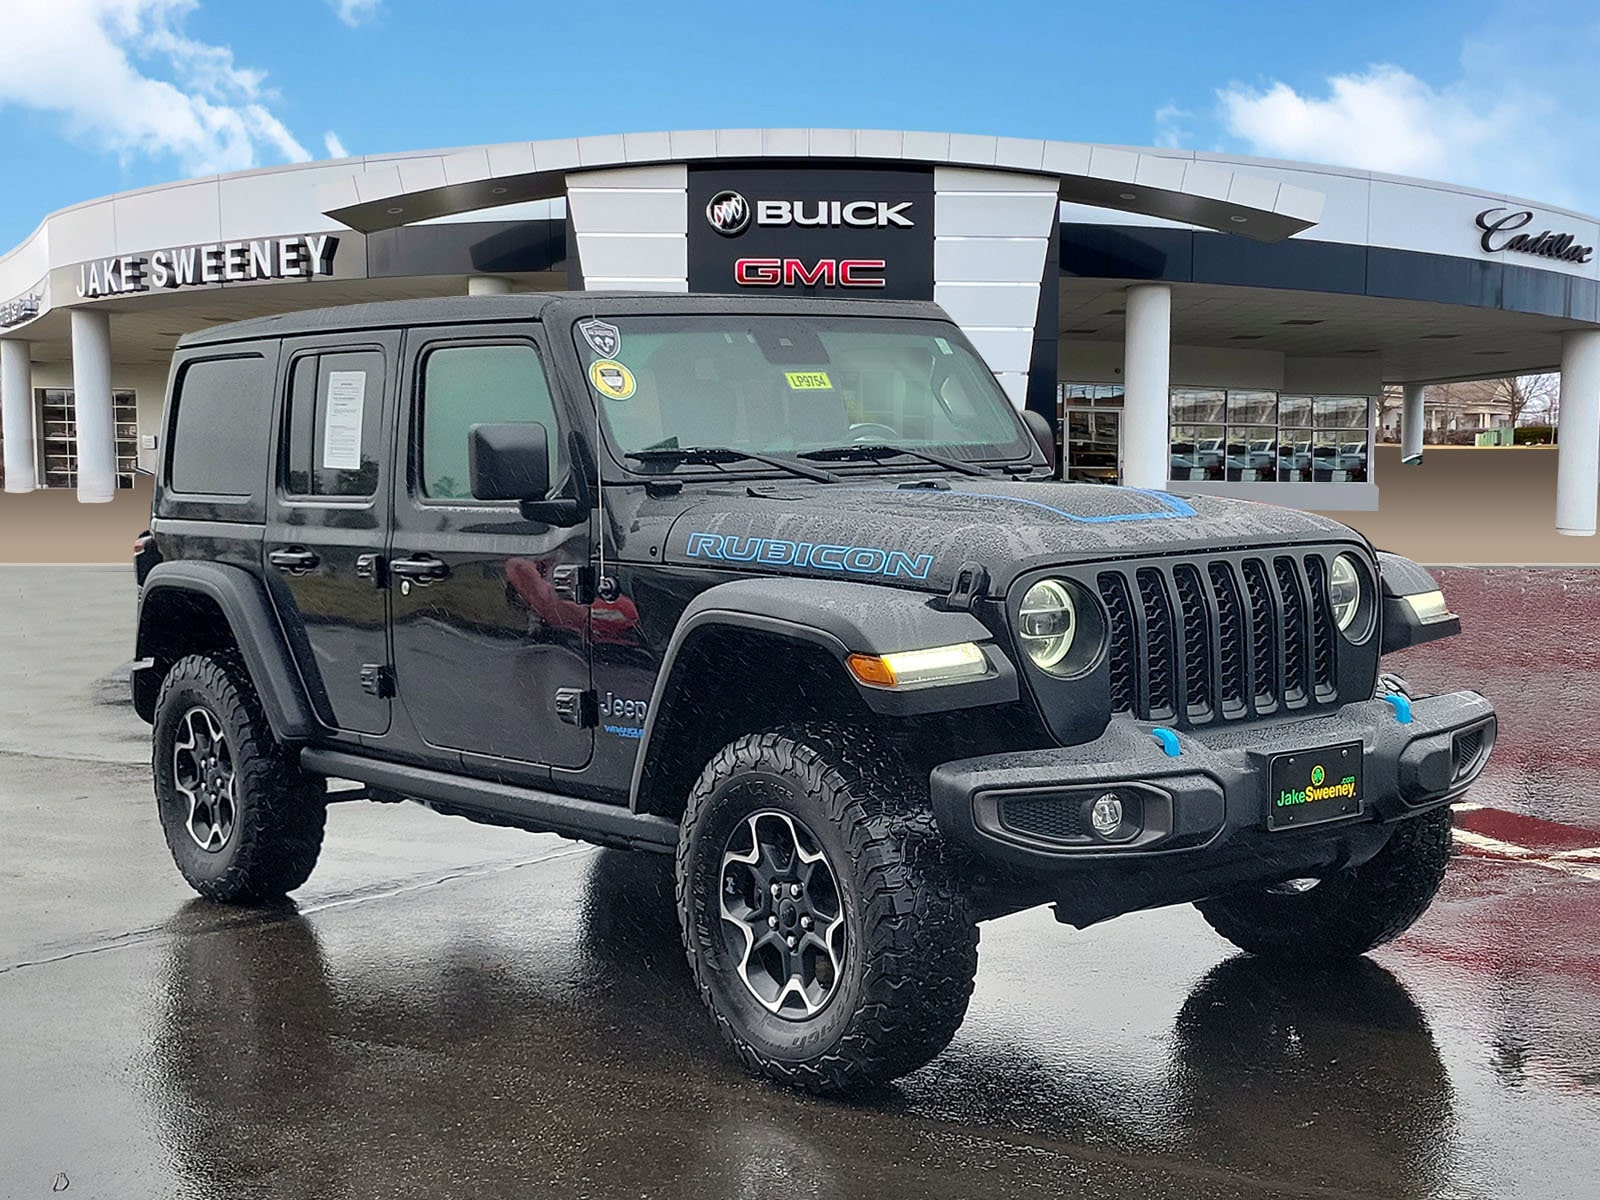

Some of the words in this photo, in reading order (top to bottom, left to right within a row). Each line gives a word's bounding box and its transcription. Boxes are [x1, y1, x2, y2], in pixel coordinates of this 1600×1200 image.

[757, 200, 915, 227] BUICK
[1475, 207, 1593, 263] Cadillac
[76, 255, 137, 298] JAKE
[151, 234, 331, 288] SWEENEY
[734, 258, 886, 287] GMC
[790, 375, 826, 387] LP9754
[686, 532, 934, 579] RUBICON
[600, 692, 647, 724] Jeep
